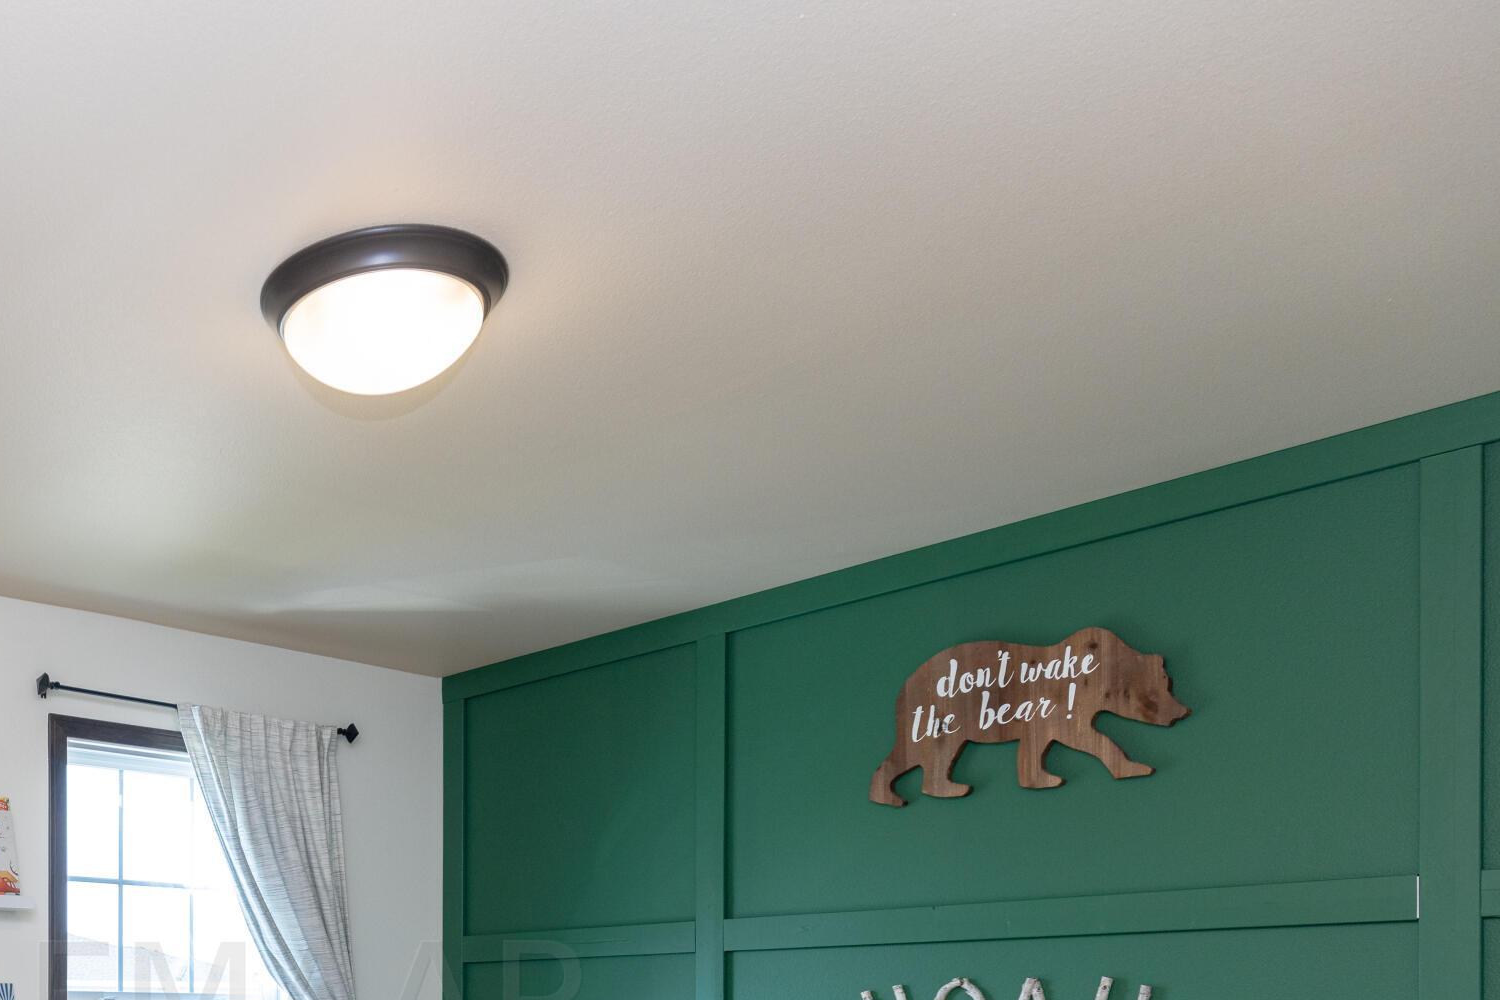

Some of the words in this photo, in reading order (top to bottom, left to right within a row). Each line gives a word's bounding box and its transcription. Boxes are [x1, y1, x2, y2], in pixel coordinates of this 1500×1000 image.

[936, 650, 1015, 699] don't
[1020, 645, 1100, 684] wake
[912, 704, 961, 743] the
